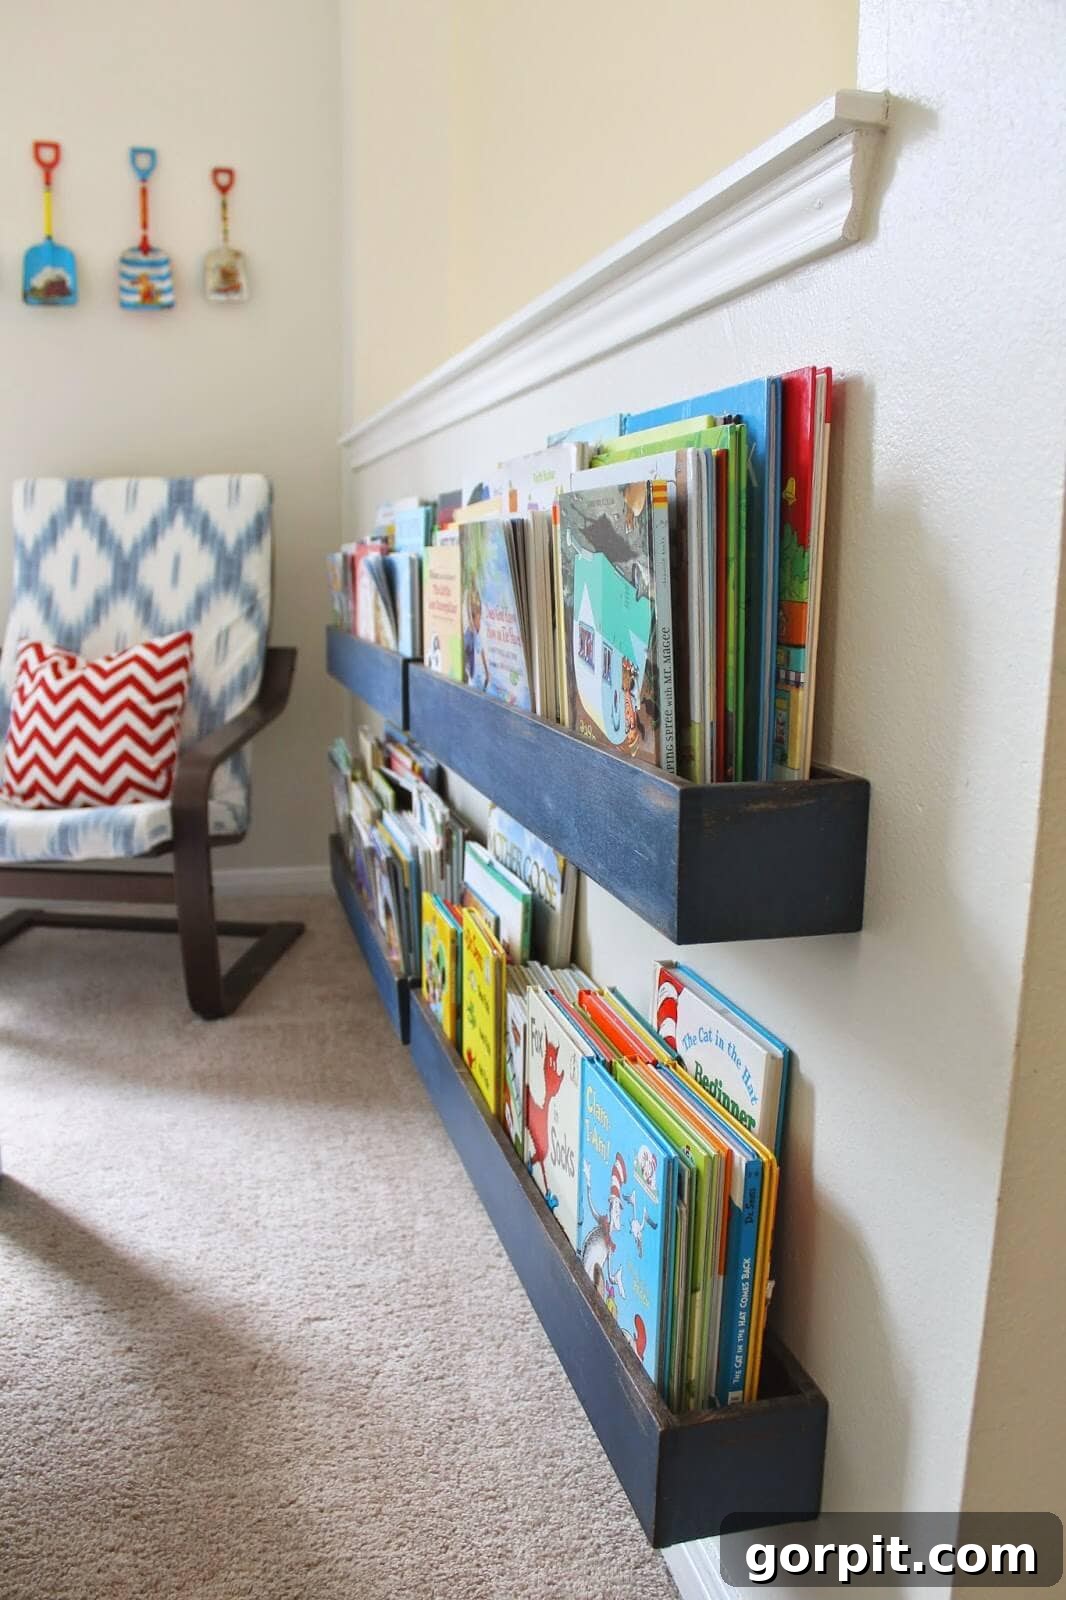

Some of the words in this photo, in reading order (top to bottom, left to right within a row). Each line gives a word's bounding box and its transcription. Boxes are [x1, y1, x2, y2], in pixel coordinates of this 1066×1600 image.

[665, 687, 673, 707] with
[531, 1017, 544, 1058] Fox
[682, 1032, 697, 1051] The
[698, 1027, 713, 1042] Cat
[715, 1029, 724, 1051] in
[727, 1041, 742, 1070] the
[742, 1065, 758, 1106] Hat
[550, 1128, 575, 1178] Socks
[741, 1257, 752, 1281] BACK
[739, 1281, 750, 1308] COMES
[738, 1311, 747, 1327] HAT
[737, 1344, 744, 1354] IN
[734, 1354, 743, 1369] CAT
